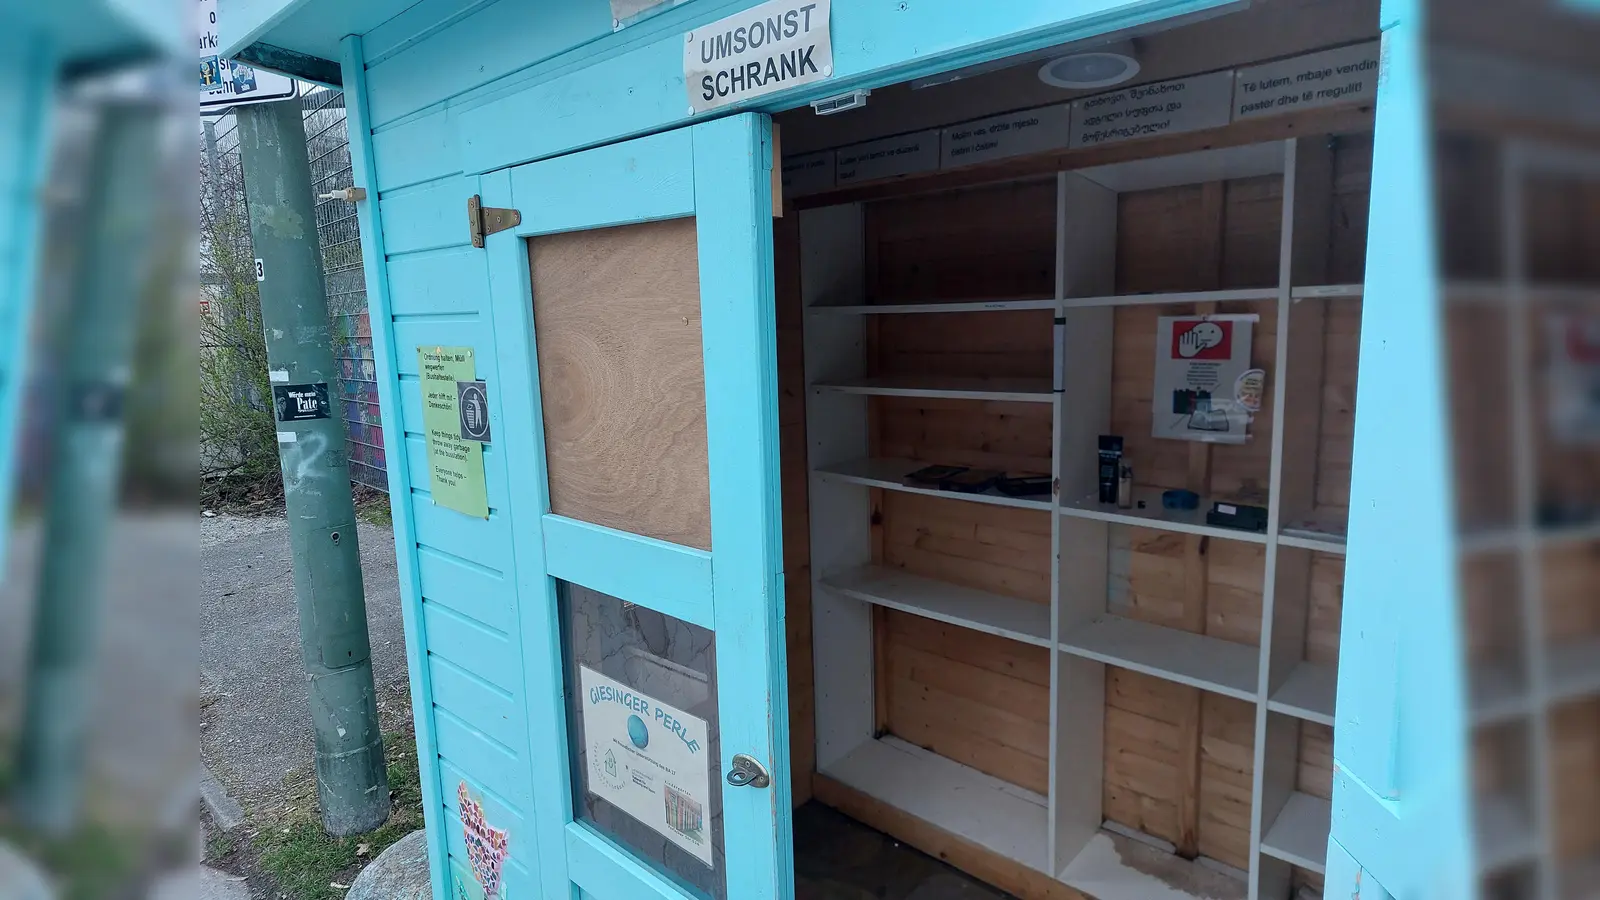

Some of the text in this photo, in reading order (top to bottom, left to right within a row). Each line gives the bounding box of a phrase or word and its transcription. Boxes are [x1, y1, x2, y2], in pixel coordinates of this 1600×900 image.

[701, 4, 816, 64] UMSONST
[702, 45, 818, 101] SCHRANK
[1296, 70, 1332, 83] mbaje
[1336, 60, 1378, 74] vendin
[256, 262, 263, 277] 3
[296, 398, 318, 410] Pate
[590, 686, 700, 754] GIESINGER PERLE
